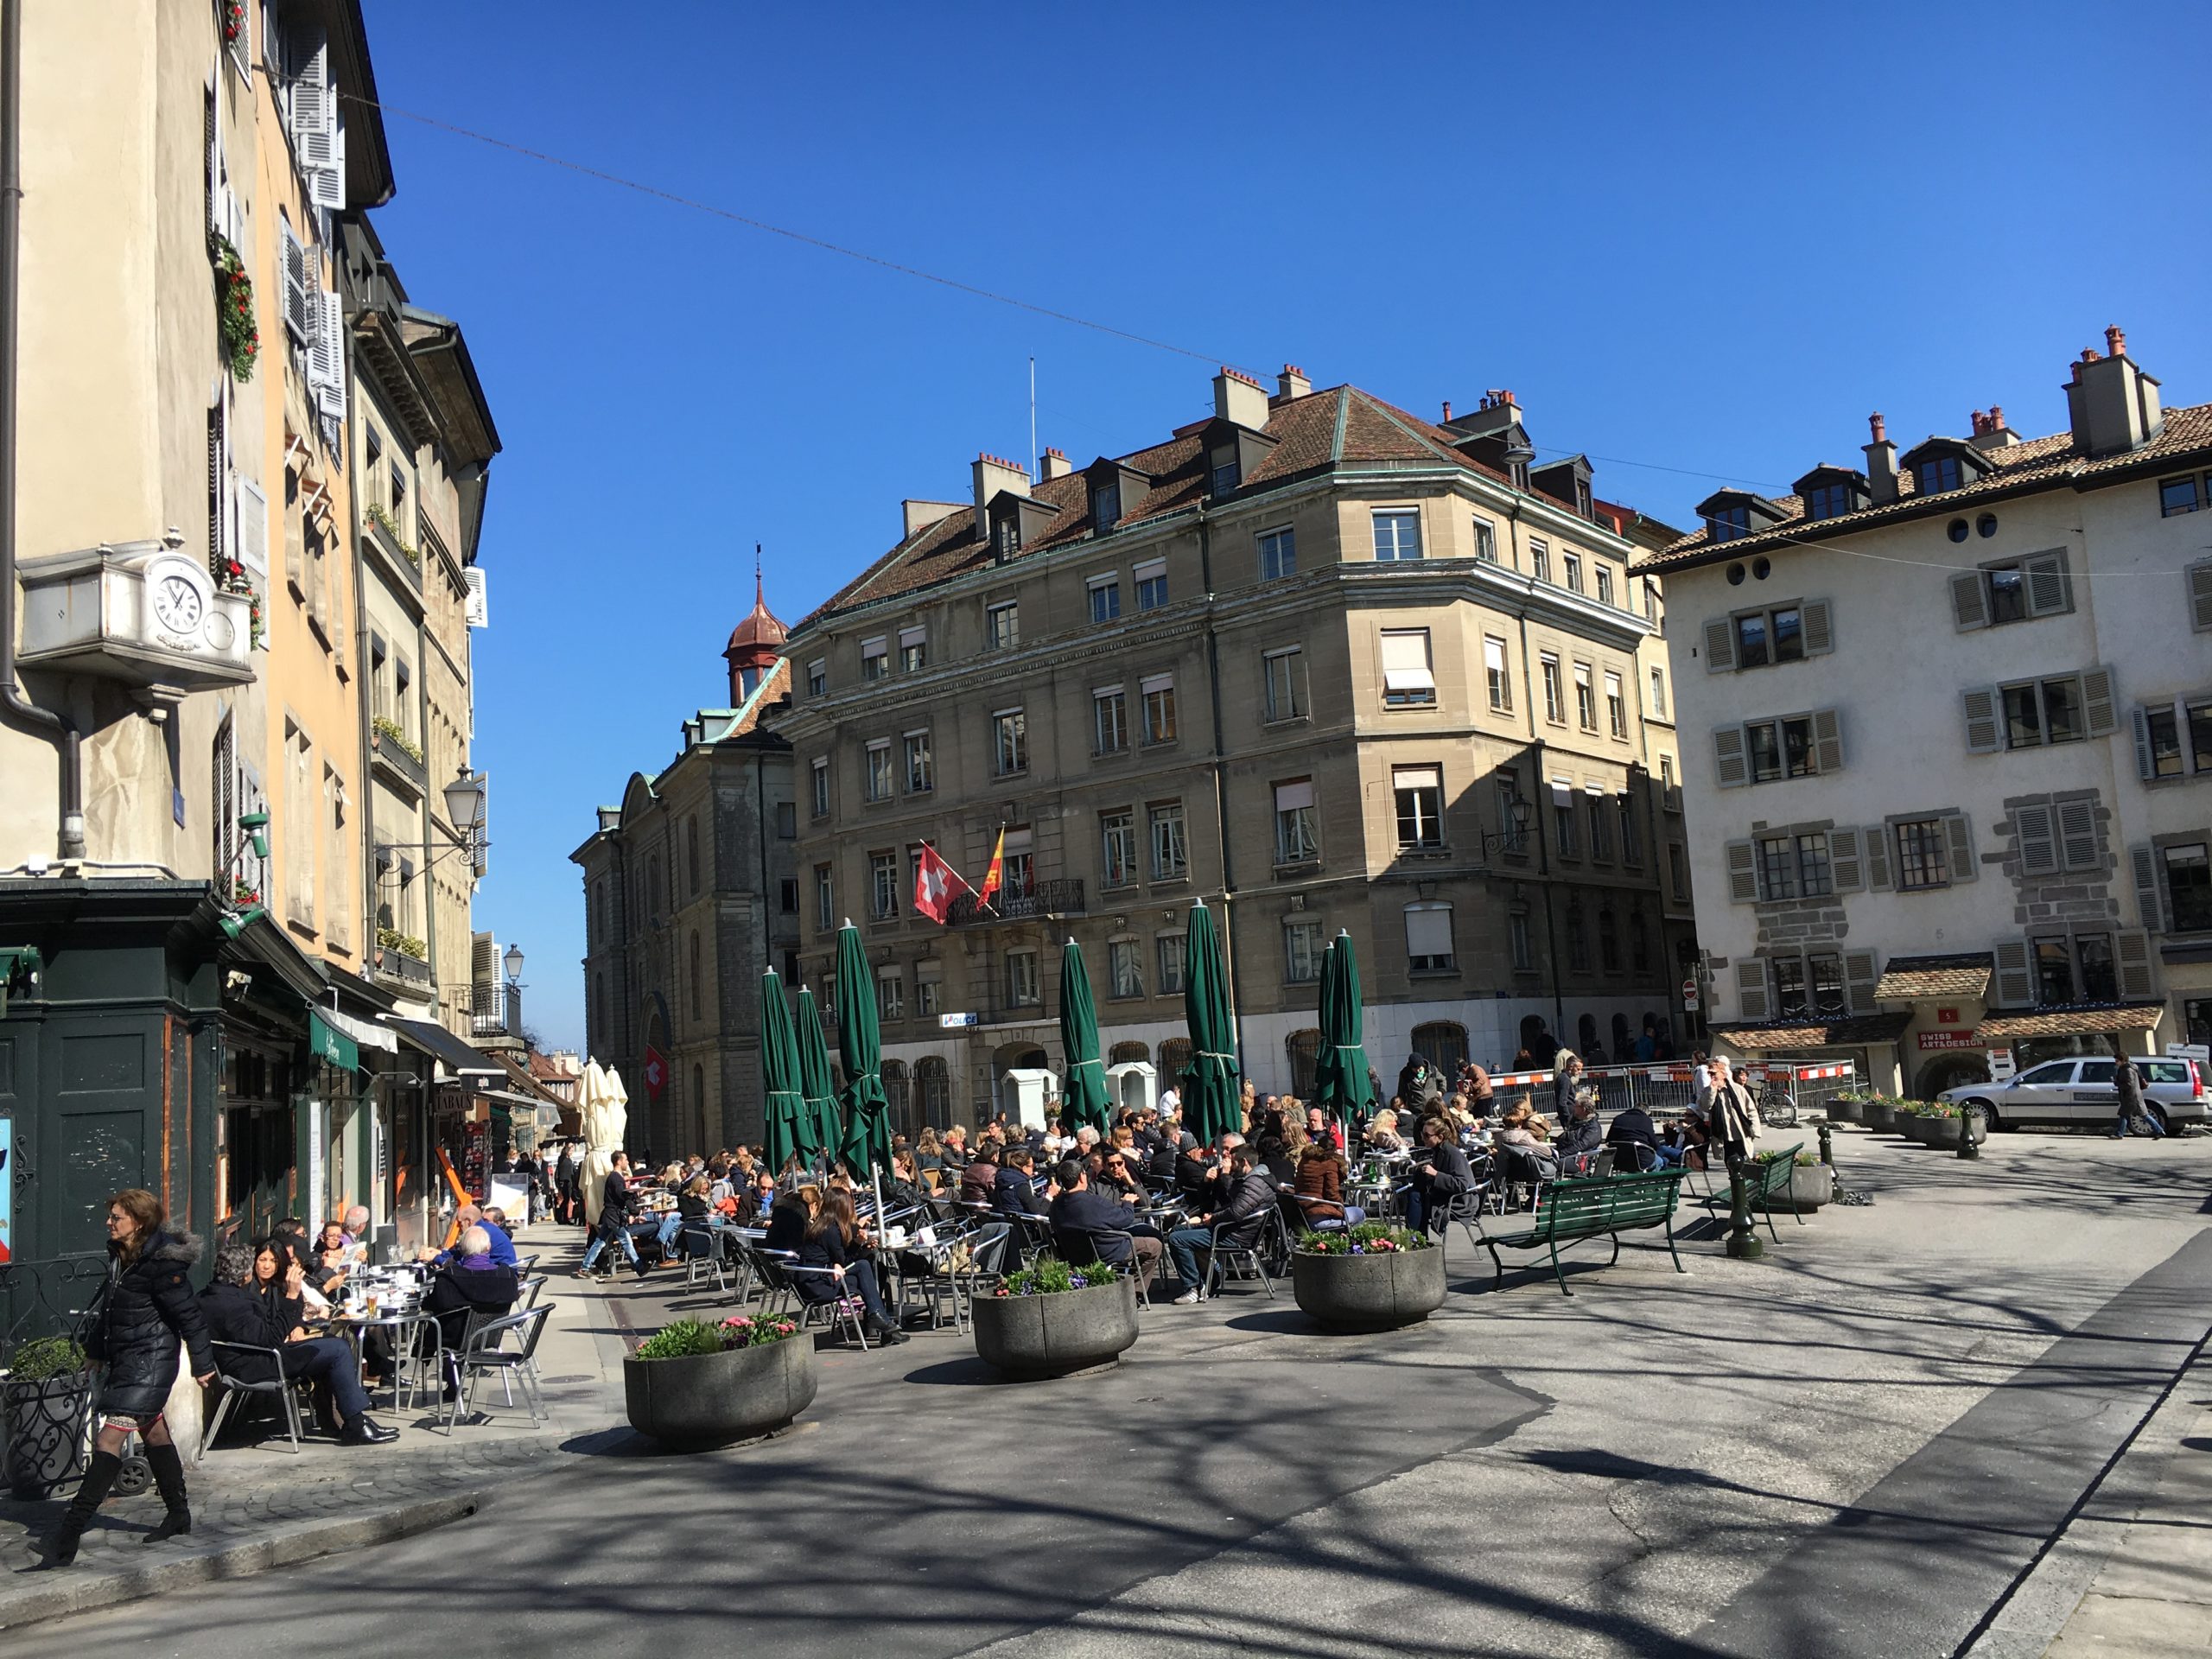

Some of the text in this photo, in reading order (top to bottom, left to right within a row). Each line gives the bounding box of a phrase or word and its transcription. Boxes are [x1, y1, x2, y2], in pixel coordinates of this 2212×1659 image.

[1936, 928, 1944, 940] 5
[944, 1014, 976, 1026] POLICE
[1920, 1033, 1952, 1041] SWISS
[1922, 1039, 1984, 1049] ART&DESIGN
[435, 1092, 473, 1110] TABACS
